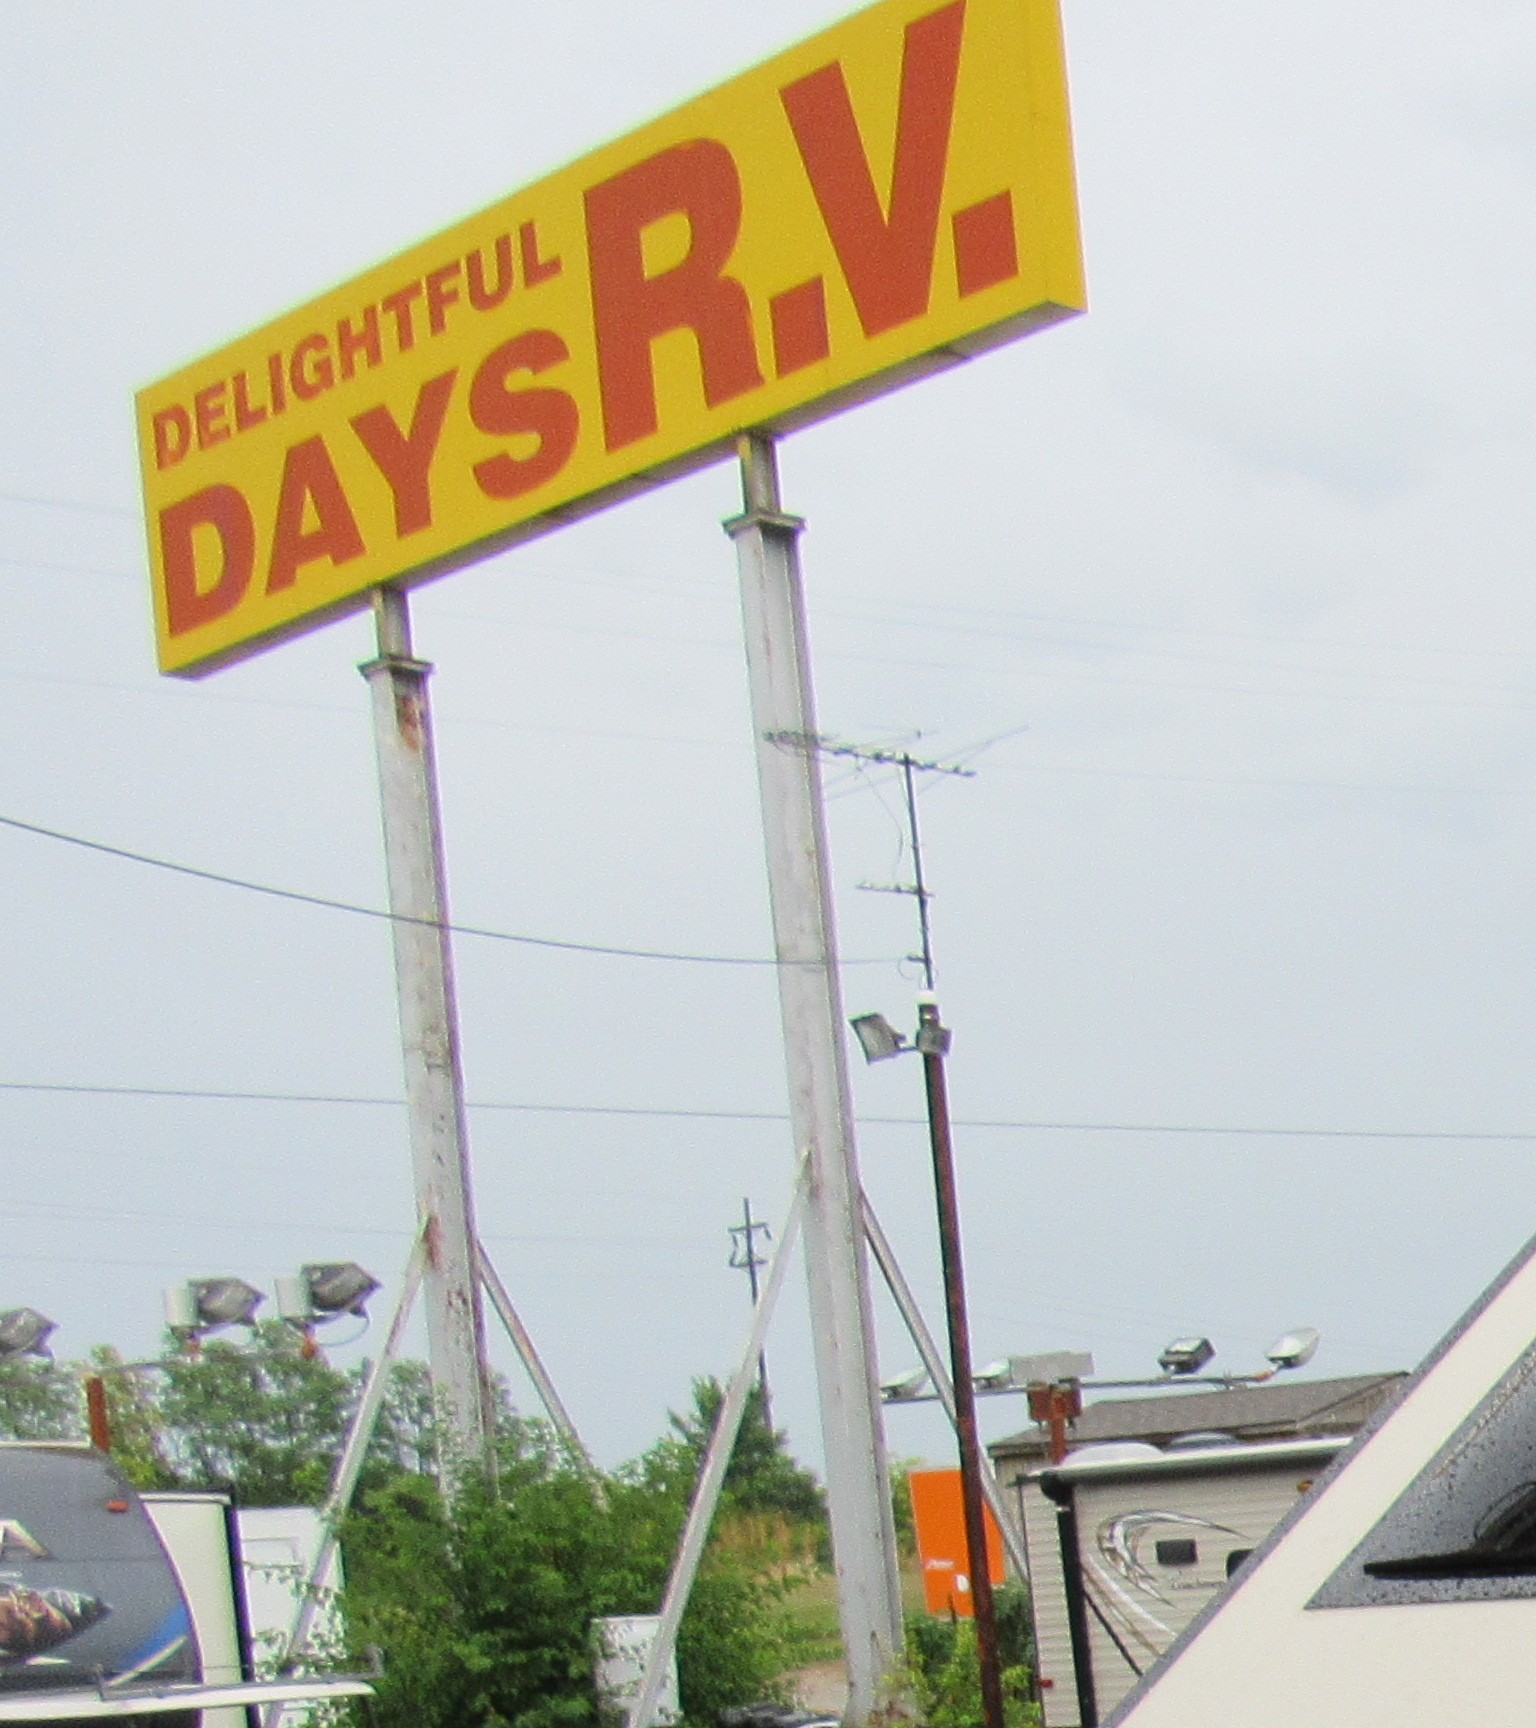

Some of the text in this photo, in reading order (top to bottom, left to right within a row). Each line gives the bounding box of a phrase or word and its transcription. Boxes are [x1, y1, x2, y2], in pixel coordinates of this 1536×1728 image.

[152, 221, 563, 470] DELIGHTFUL
[158, 0, 1020, 638] DAYS R.V.
